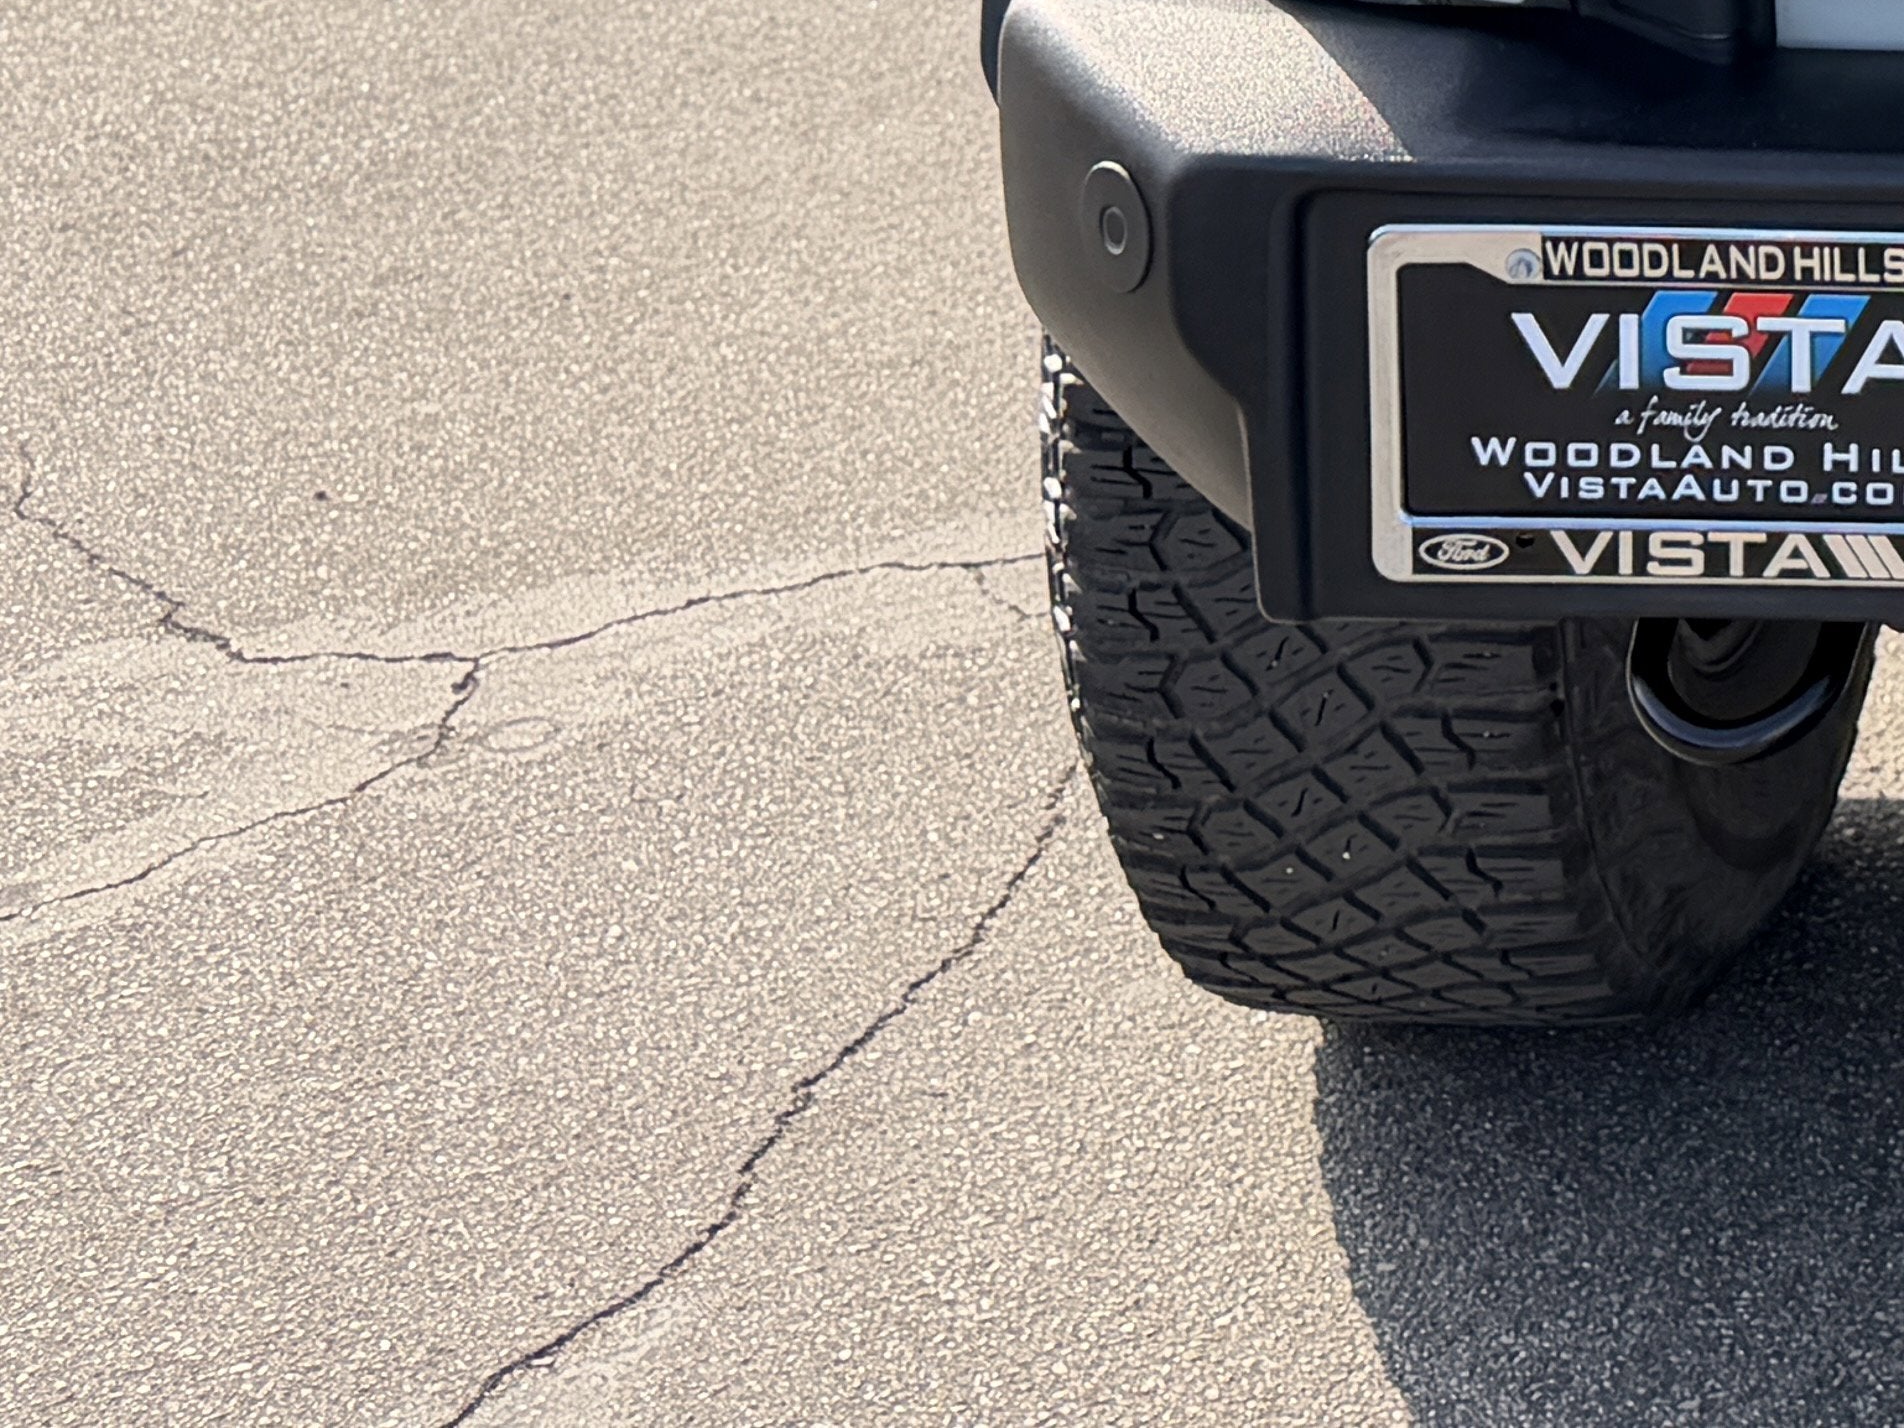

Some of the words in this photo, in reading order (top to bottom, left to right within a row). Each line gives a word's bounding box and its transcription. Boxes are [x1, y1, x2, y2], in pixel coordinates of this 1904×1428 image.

[1545, 240, 1786, 281] WOODLAND
[1614, 408, 1634, 426] a
[1636, 397, 1722, 442] family
[1730, 403, 1840, 431] tradition
[1471, 436, 1795, 473] WOODLAND
[1434, 538, 1492, 565] Ford
[1550, 530, 1832, 578] VISTA
